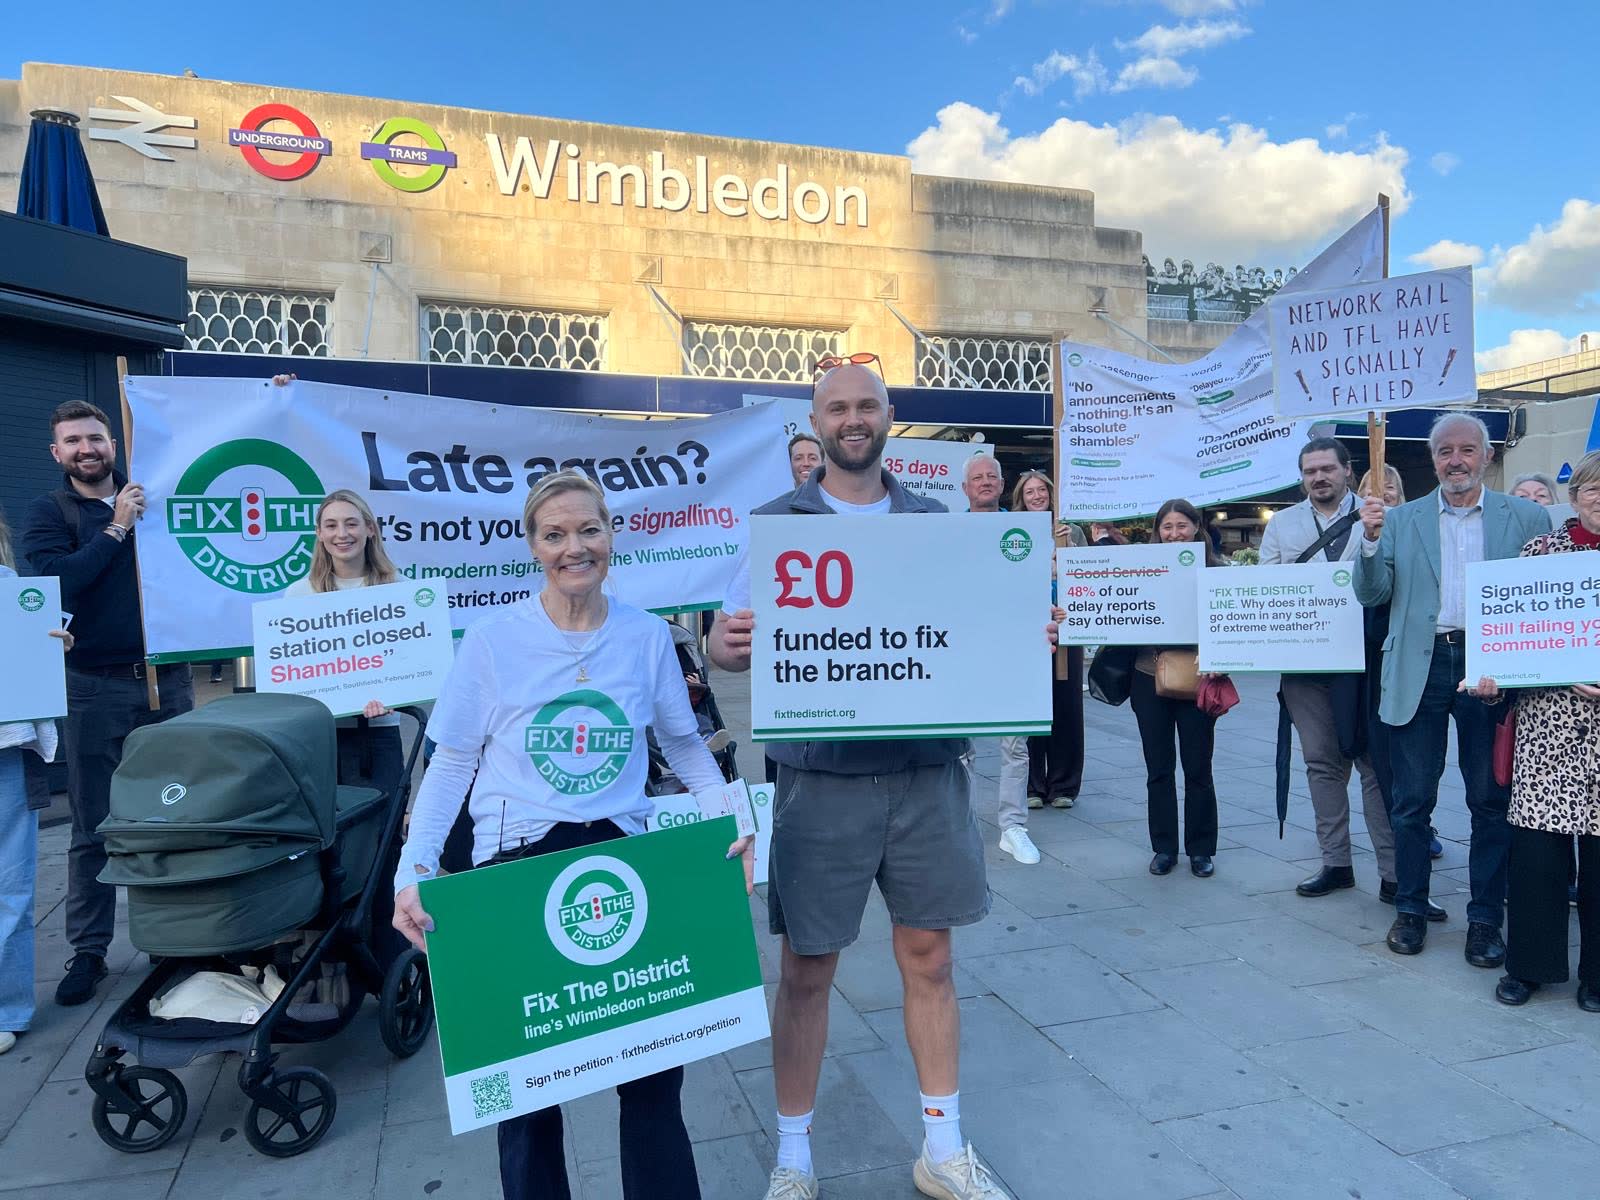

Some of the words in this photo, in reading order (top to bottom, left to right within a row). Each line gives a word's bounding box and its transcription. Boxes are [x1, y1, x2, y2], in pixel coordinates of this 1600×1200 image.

[232, 130, 325, 151] UNDERGROUND
[388, 146, 428, 162] TRAMS
[485, 133, 868, 227] Wimbledon
[1289, 291, 1383, 325] NETWORK
[1396, 282, 1448, 309] RAIL
[1291, 331, 1328, 355] AND
[1344, 323, 1381, 348] TFL
[1398, 313, 1451, 340] HAVE
[1321, 347, 1424, 379] SIGNALLY
[1069, 381, 1093, 393] “No
[1332, 379, 1413, 406] FAILED
[1069, 391, 1176, 407] announcements
[1077, 406, 1132, 420] nothing.
[1133, 405, 1154, 417] It's
[1156, 404, 1174, 414] an
[1070, 422, 1127, 434] absolute
[360, 431, 514, 493] Late
[908, 460, 949, 479] days
[924, 480, 956, 491] failure.
[172, 502, 235, 529] FIX
[1069, 502, 1138, 512] fixthedistrict.org
[377, 515, 412, 542] t's
[420, 516, 472, 542] not
[628, 503, 739, 535] signalling.
[634, 544, 722, 565] Wimbledon
[1003, 550, 1029, 561] DISTRICT
[193, 542, 314, 591] DISTRICT
[421, 562, 497, 579] modern
[774, 550, 854, 609] £0
[1067, 586, 1096, 597] 48%
[1099, 585, 1112, 597] of
[1116, 586, 1139, 597] our
[1235, 587, 1258, 596] THE
[1261, 585, 1315, 596] DISTRICT
[1481, 581, 1574, 601] Signalling
[1068, 601, 1103, 614] delay
[1107, 600, 1156, 613] reports
[1210, 600, 1238, 609] LINE.
[1241, 599, 1265, 610] Why
[1268, 597, 1295, 608] does
[1298, 597, 1306, 607] it
[1308, 596, 1347, 609] always
[1481, 600, 1526, 616] back
[1531, 599, 1549, 612] to
[1554, 596, 1586, 610] the
[268, 603, 406, 635] “Southfields
[1068, 616, 1091, 628] say
[1095, 614, 1165, 626] otherwise.
[1210, 614, 1223, 623] go
[1226, 611, 1256, 621] down
[1259, 611, 1270, 620] in
[1272, 612, 1293, 621] any
[1295, 609, 1318, 619] sort
[1210, 623, 1221, 633] of
[1223, 624, 1267, 633] extreme
[1481, 622, 1514, 637] Still
[1520, 620, 1575, 635] failing
[269, 636, 346, 660] station
[352, 621, 432, 648] closed.
[773, 627, 872, 652] funded
[880, 628, 908, 650] to
[915, 625, 949, 649] fix
[1481, 637, 1565, 653] commute
[1571, 635, 1588, 648] in
[271, 648, 394, 684] Shambles”
[774, 660, 818, 683] the
[827, 657, 932, 683] branch.
[385, 673, 415, 683] February
[774, 709, 856, 720] fixthedistrict.org
[528, 729, 568, 749] FIX
[592, 732, 631, 748] THE
[538, 759, 619, 792] DISTRICT
[560, 906, 590, 925] FIX
[603, 895, 633, 913] THE
[571, 917, 629, 949] DISTRICT
[523, 992, 560, 1017] Fix
[563, 980, 608, 1005] The
[612, 954, 691, 993] District
[525, 1019, 563, 1040] line’s
[566, 995, 645, 1027] Wimbledon
[648, 981, 695, 1005] branch
[525, 1075, 551, 1089] Sign
[553, 1068, 571, 1081] the
[574, 1055, 613, 1077] petition
[621, 1015, 742, 1060] fixthedistrict.org/petition
